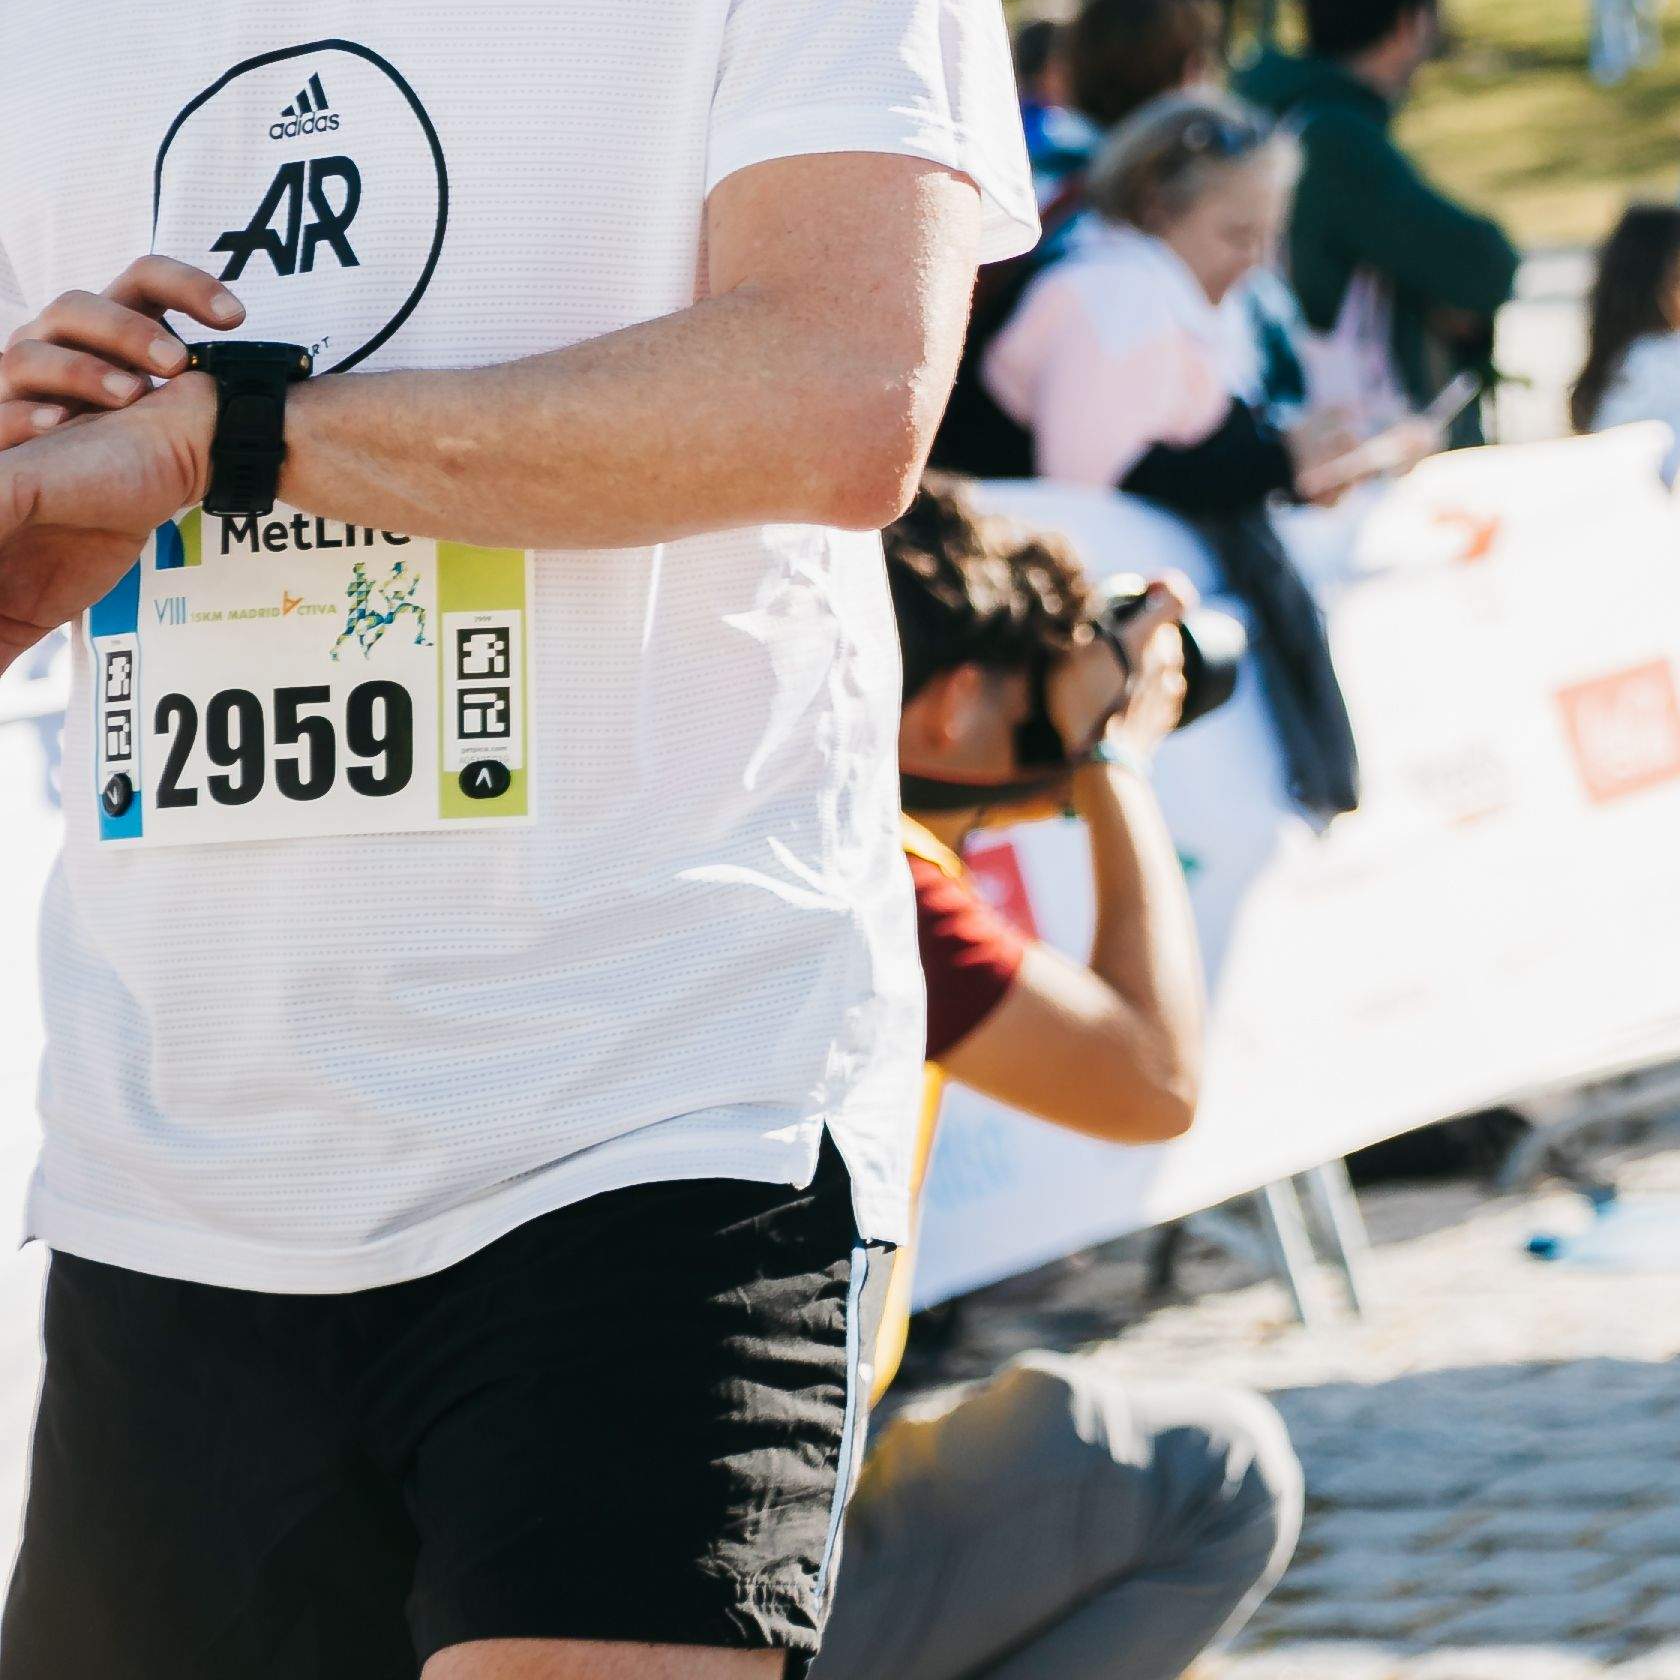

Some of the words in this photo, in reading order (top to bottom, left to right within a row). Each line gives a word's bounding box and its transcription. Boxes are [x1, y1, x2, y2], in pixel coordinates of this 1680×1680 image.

[269, 110, 340, 140] adidas
[209, 155, 361, 281] AR
[154, 597, 186, 626] VIII
[227, 607, 280, 620] MADRID
[153, 680, 413, 809] 2959
